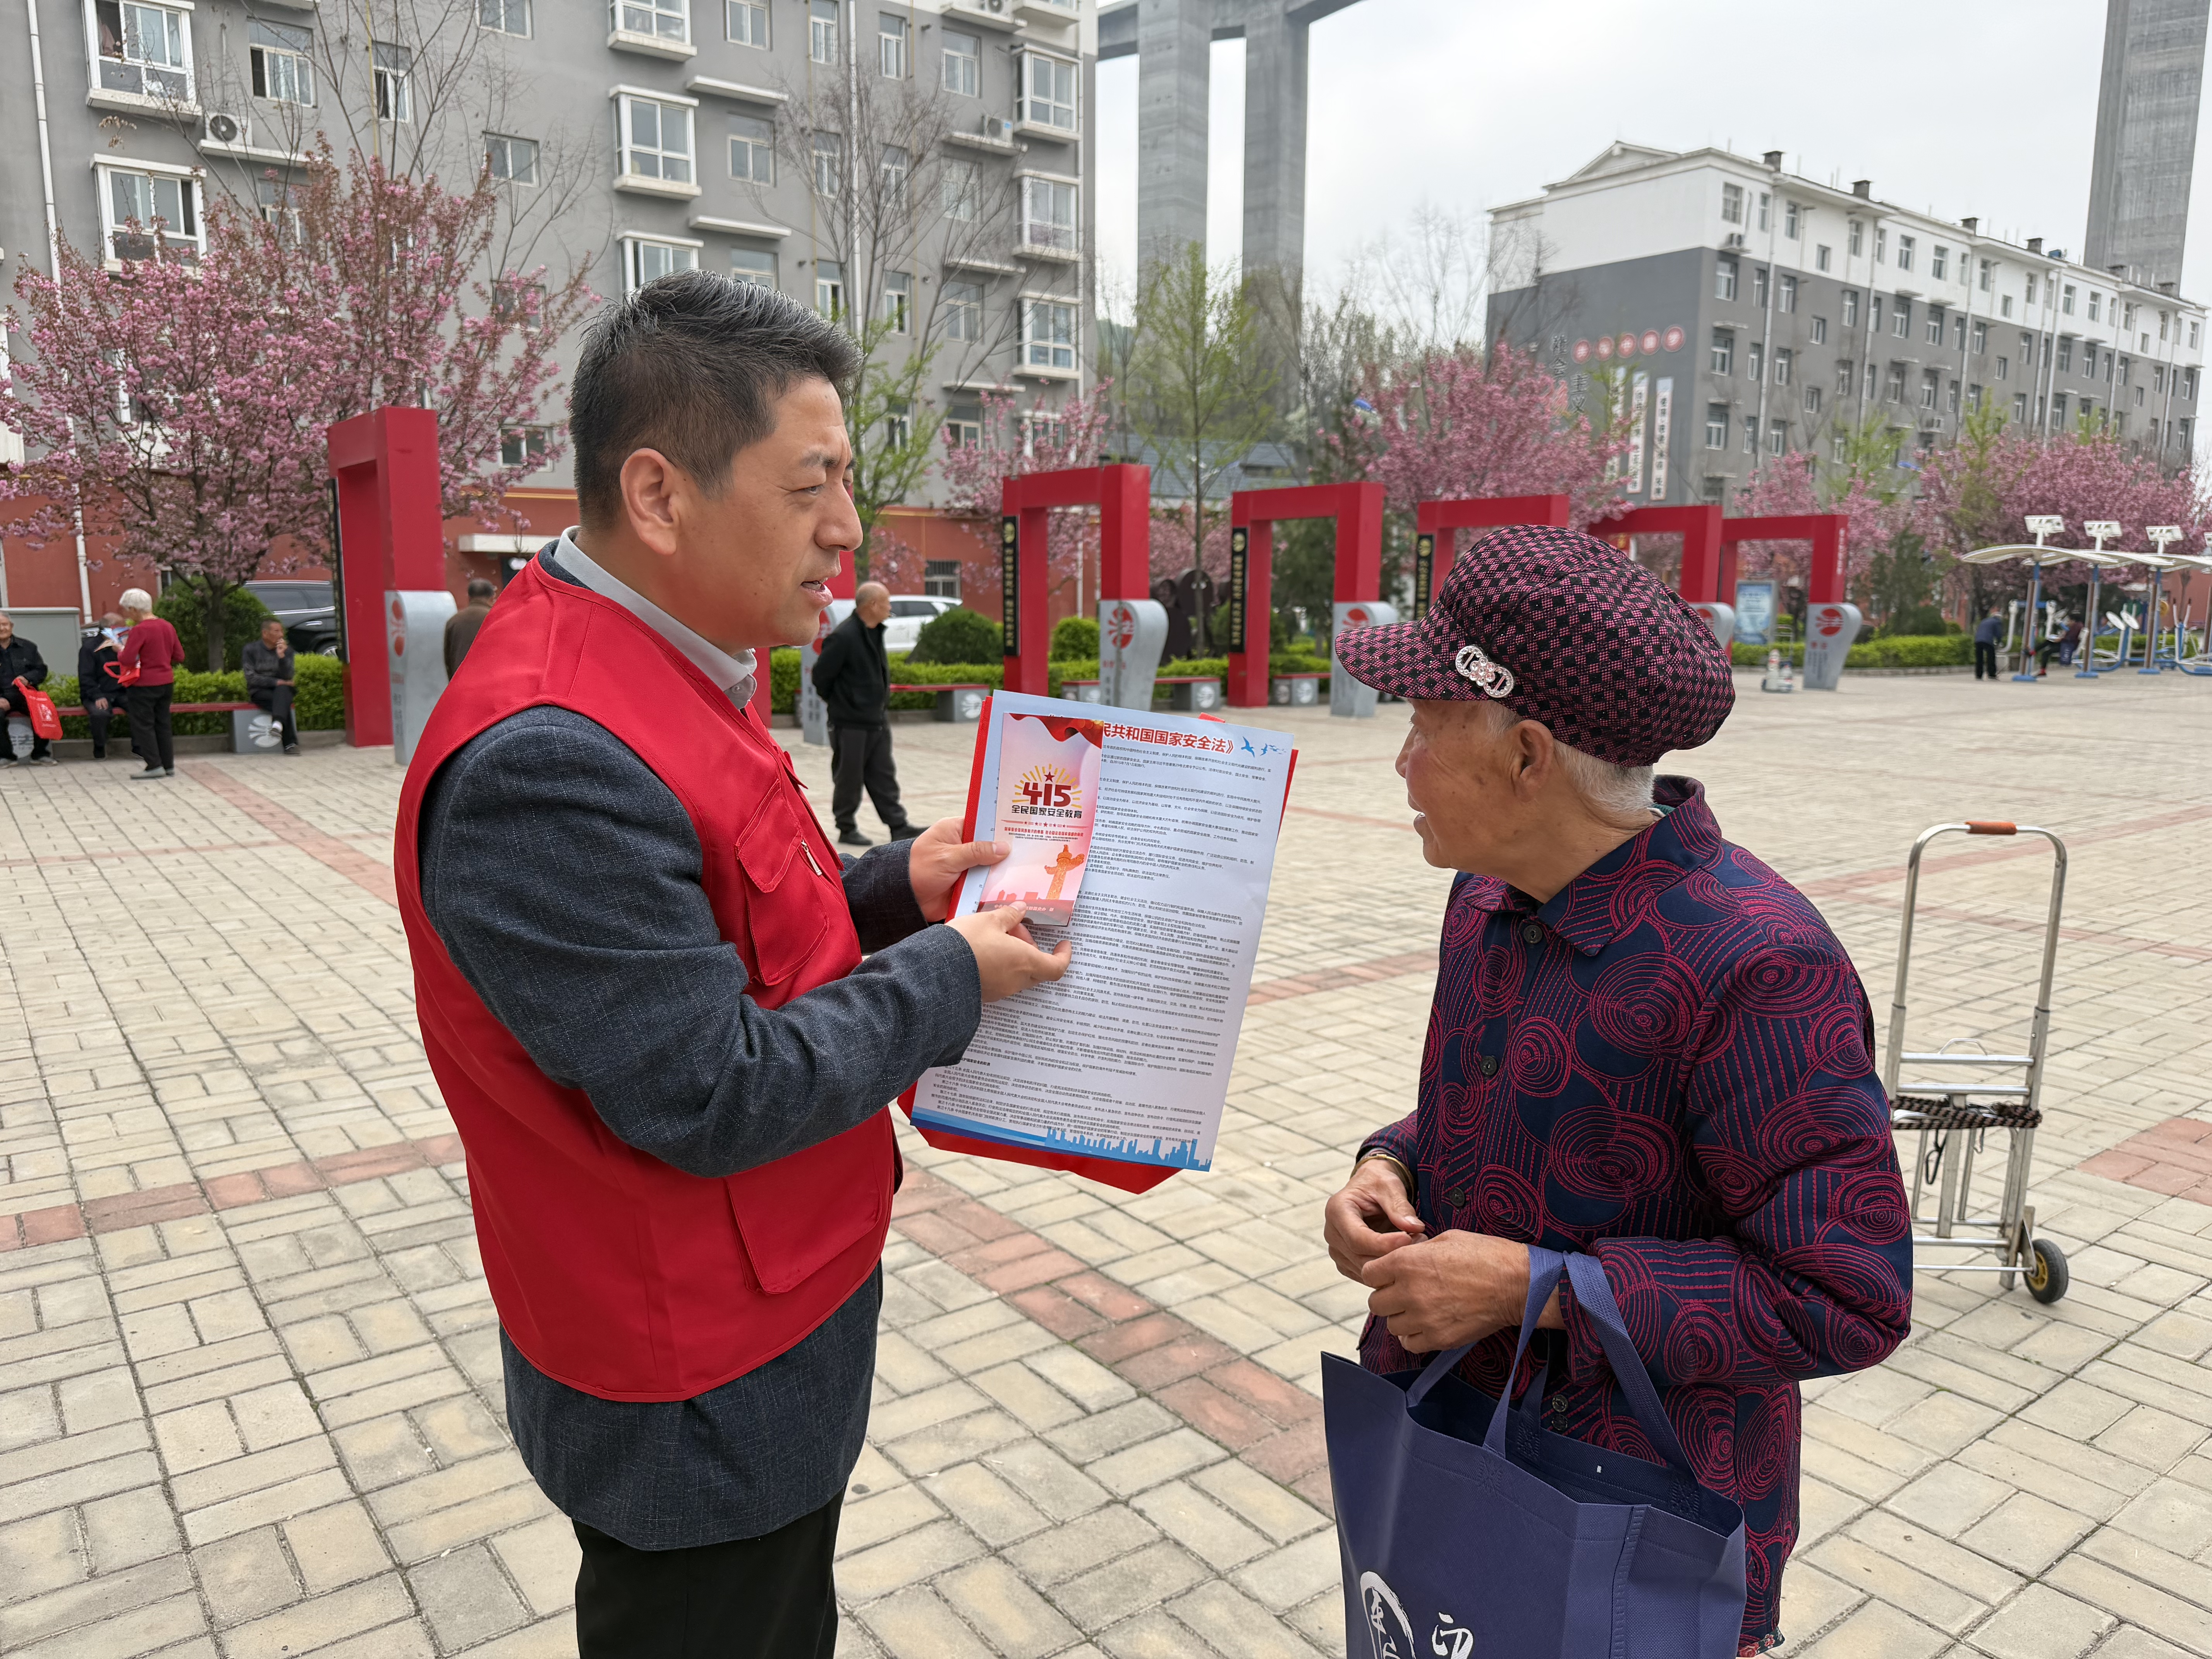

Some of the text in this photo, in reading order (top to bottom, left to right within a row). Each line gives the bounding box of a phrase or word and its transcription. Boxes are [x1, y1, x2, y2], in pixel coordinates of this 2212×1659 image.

[1022, 782, 1072, 807] 415
[1012, 805, 1082, 819] 全民国家安全教育
